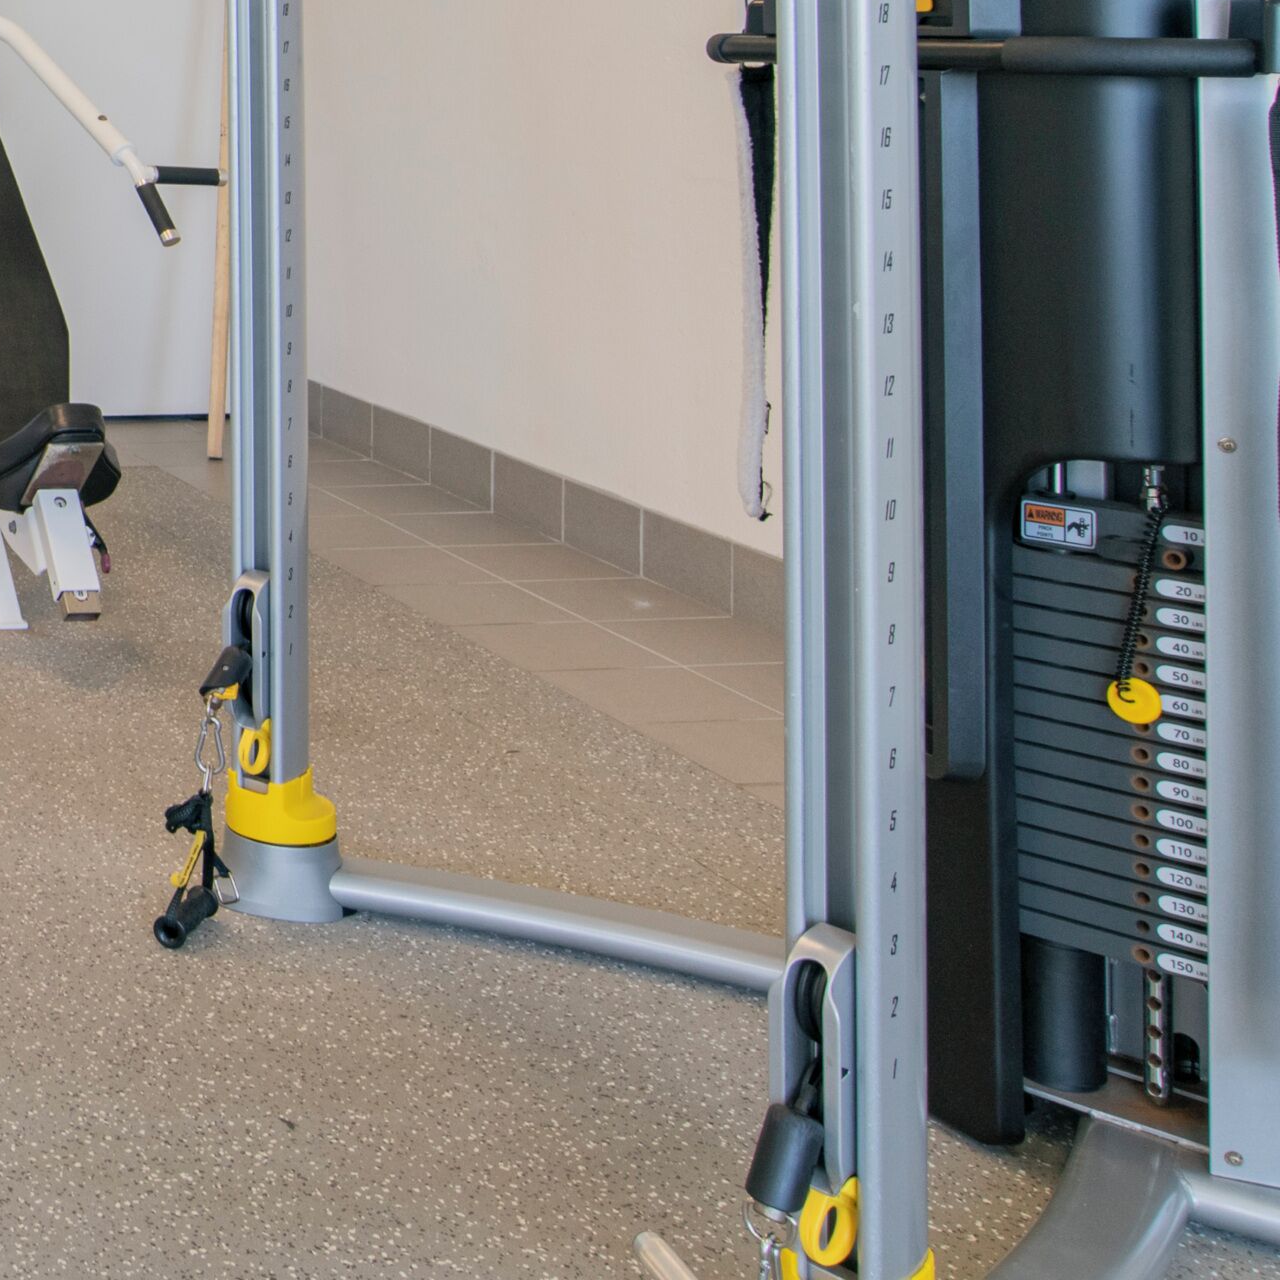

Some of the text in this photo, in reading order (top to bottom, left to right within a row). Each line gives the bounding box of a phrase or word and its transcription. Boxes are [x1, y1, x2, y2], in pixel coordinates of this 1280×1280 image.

[878, 2, 890, 24] 18
[282, 40, 290, 54] 17
[879, 64, 891, 86] 17
[283, 115, 291, 130] 15
[880, 126, 892, 148] 16
[284, 153, 291, 167] 14
[881, 188, 893, 210] 15
[284, 228, 293, 243] 12
[882, 250, 893, 273] 14
[286, 266, 292, 280] 11
[882, 312, 895, 335] 13
[883, 374, 896, 397] 12
[885, 437, 895, 459] 11
[885, 498, 897, 521] 10
[1184, 531, 1198, 541] 10
[887, 561, 896, 583] 9
[1176, 586, 1192, 597] 20
[1173, 614, 1189, 625] 30
[887, 623, 896, 645] 8
[1173, 643, 1189, 654] 40
[1173, 671, 1189, 682] 50
[888, 685, 897, 708] 7
[1172, 701, 1189, 711] 60
[1173, 729, 1190, 742] 70
[888, 747, 897, 770] 6
[1173, 759, 1189, 770] 80
[1172, 787, 1189, 800] 90
[889, 809, 898, 832] 5
[1169, 815, 1194, 830] 100
[1169, 844, 1193, 859] 110
[890, 871, 897, 893] 4
[1169, 872, 1193, 887] 120
[1171, 901, 1195, 916] 130
[1169, 929, 1194, 944] 140
[890, 933, 899, 956] 3
[1170, 959, 1194, 974] 150
[890, 995, 899, 1019] 2
[892, 1058, 898, 1080] 1
